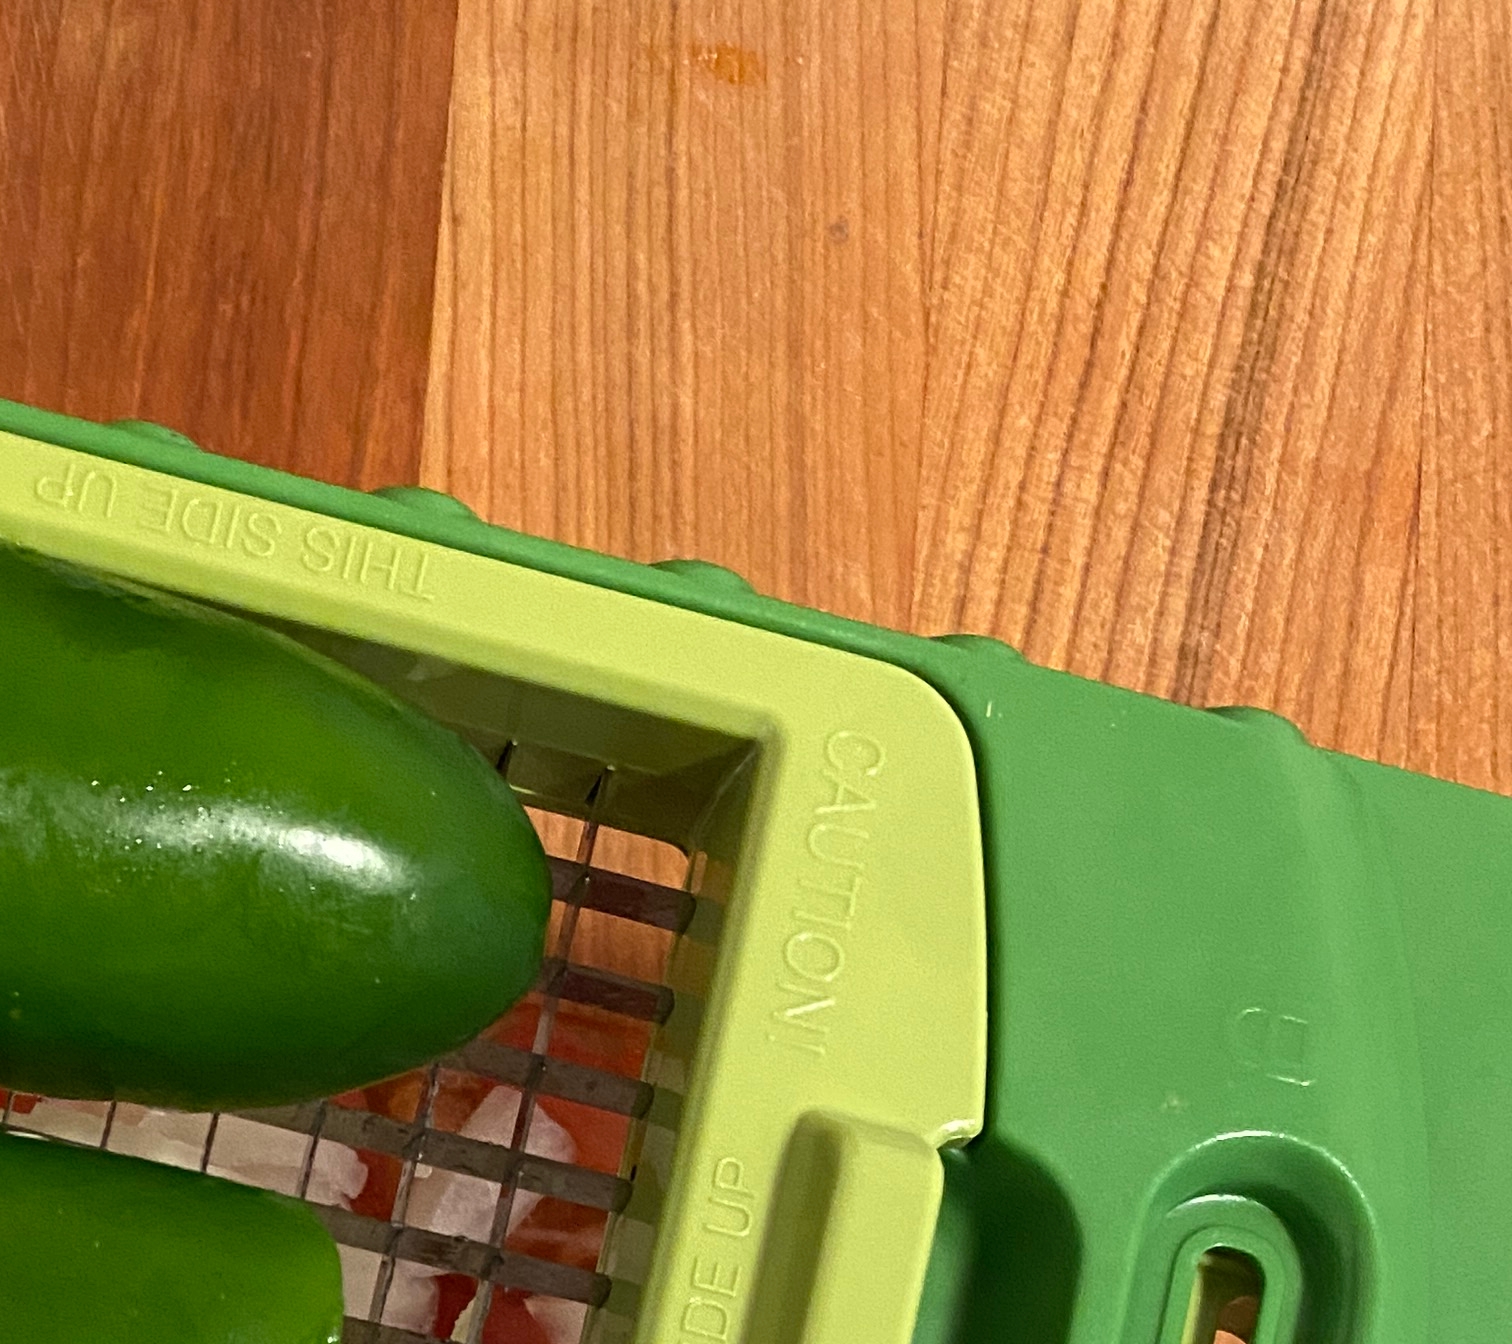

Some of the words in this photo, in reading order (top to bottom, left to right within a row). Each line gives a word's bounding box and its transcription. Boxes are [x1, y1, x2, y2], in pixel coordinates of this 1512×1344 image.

[35, 463, 118, 519] UP
[141, 486, 283, 559] SIDE
[301, 526, 435, 601] THIS
[767, 729, 886, 1057] CAUTION!
[702, 1156, 756, 1238] UP
